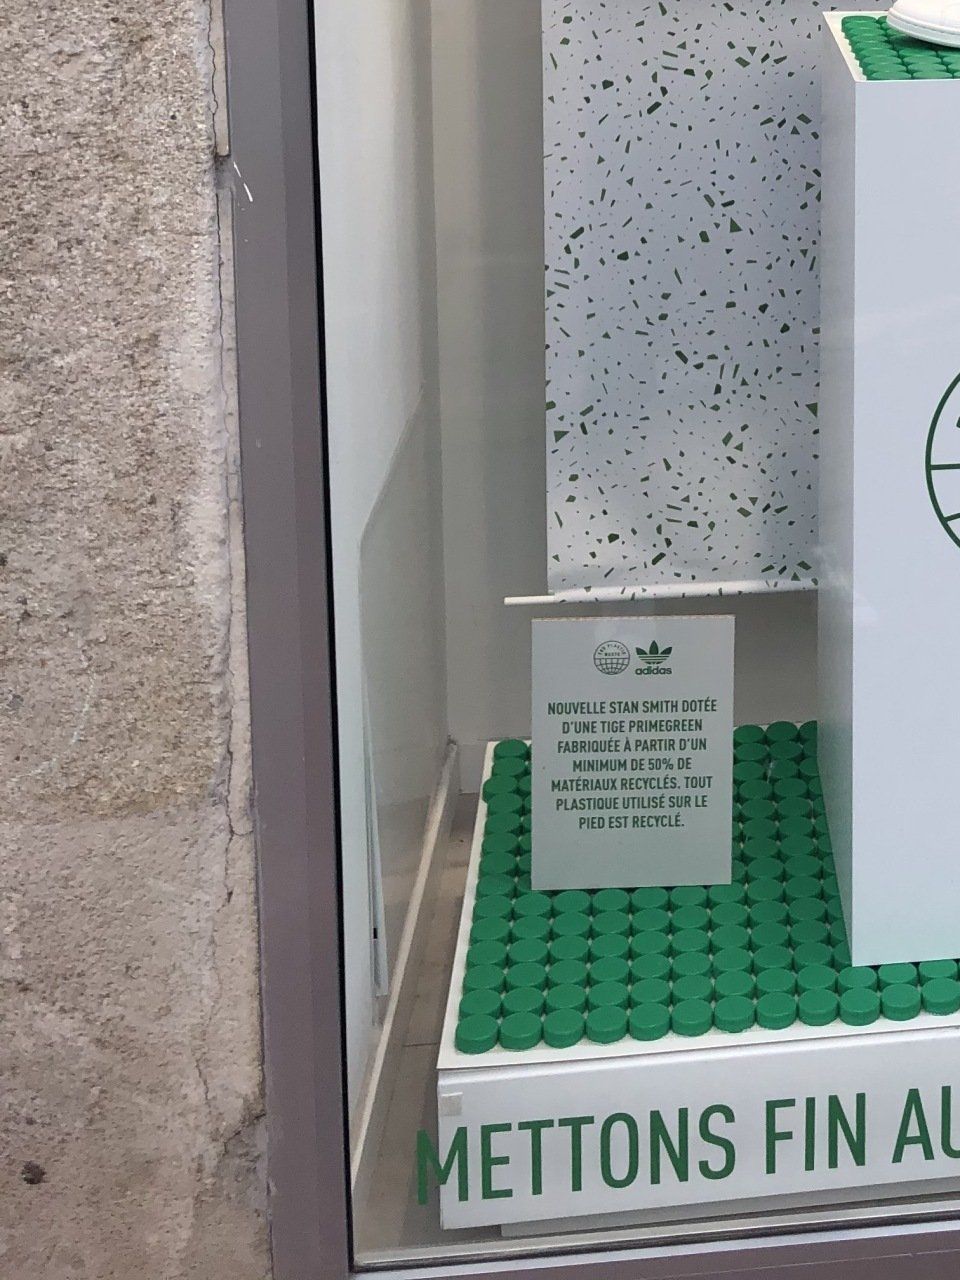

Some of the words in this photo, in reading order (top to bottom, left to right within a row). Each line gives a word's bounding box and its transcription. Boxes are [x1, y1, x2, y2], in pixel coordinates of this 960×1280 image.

[635, 666, 672, 675] adidas
[548, 701, 606, 715] NOUVELLE
[609, 701, 639, 714] STAN
[643, 700, 678, 714] SMITH
[682, 698, 717, 712] DOTÉE
[562, 721, 597, 734] D'UNE
[601, 720, 626, 733] TIGE
[629, 719, 702, 733] PRIMEGREEN
[558, 737, 620, 754] FABRIQUÉE
[624, 737, 631, 752] À
[635, 739, 675, 752] PARTIR
[679, 738, 706, 751] D'UN
[573, 759, 627, 772] MINIMUM
[631, 759, 645, 771] DE
[648, 758, 674, 771] 50%
[677, 758, 691, 770] DE
[551, 777, 617, 792] MATÉRIAUX
[621, 775, 680, 791] RECYCLÉS.
[685, 776, 713, 789] TOUT
[556, 798, 618, 811] PLASTIQUE
[622, 794, 665, 810] UTILISÉ
[668, 796, 691, 808] SUR
[695, 795, 708, 807] LE
[579, 817, 604, 830] PIED
[609, 816, 628, 828] EST
[632, 813, 685, 828] RECYCLÉ.
[416, 1104, 736, 1205] METTONS
[764, 1092, 866, 1174] FIN
